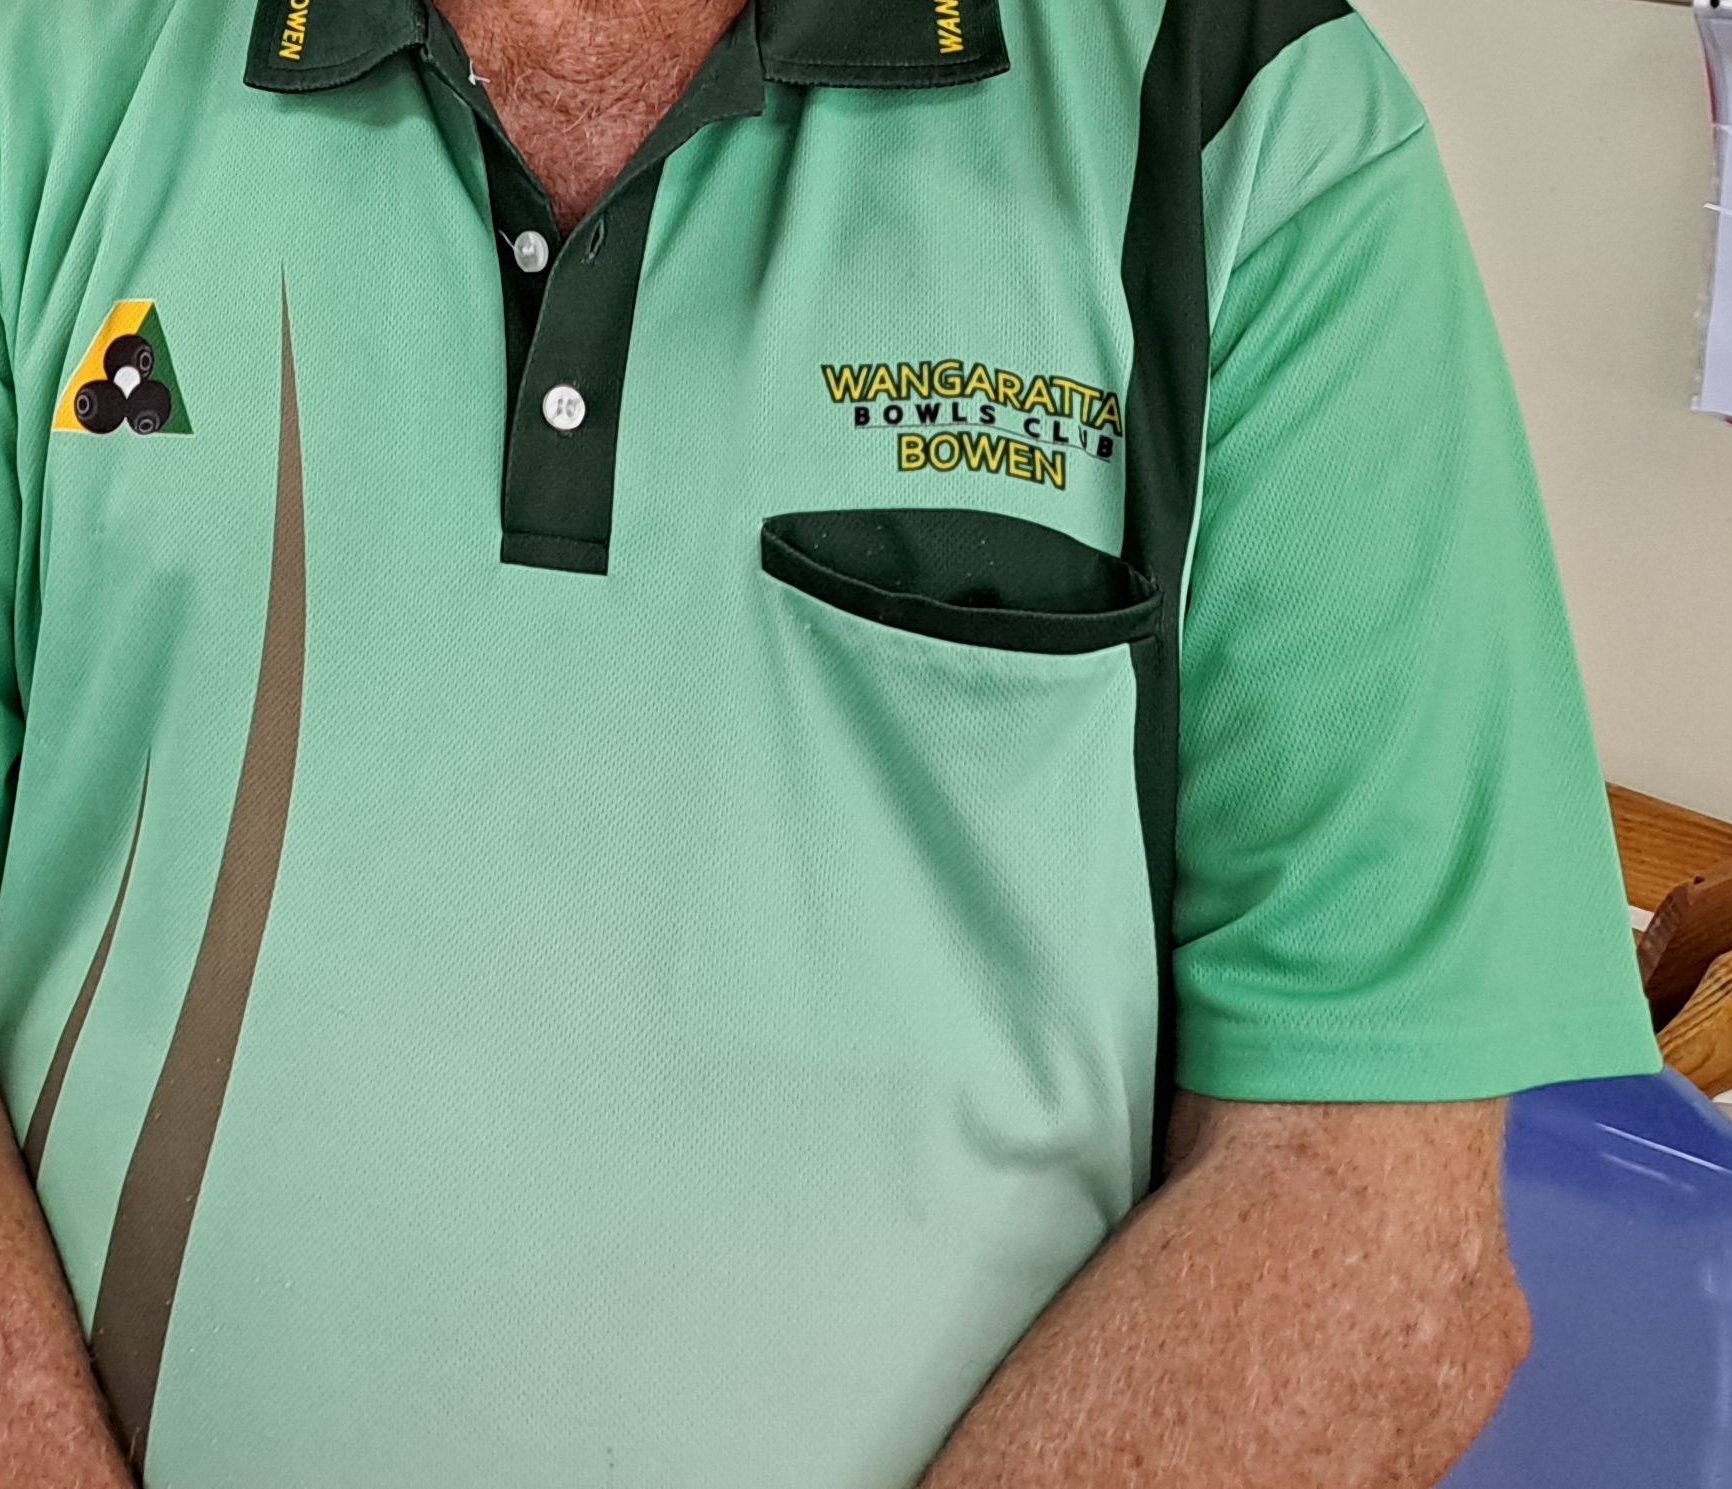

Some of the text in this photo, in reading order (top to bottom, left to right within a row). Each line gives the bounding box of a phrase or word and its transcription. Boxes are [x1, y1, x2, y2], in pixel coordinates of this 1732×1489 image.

[821, 358, 1123, 438] WANGARATTA
[854, 402, 997, 427] BOWLS
[897, 430, 1066, 491] BOWEN
